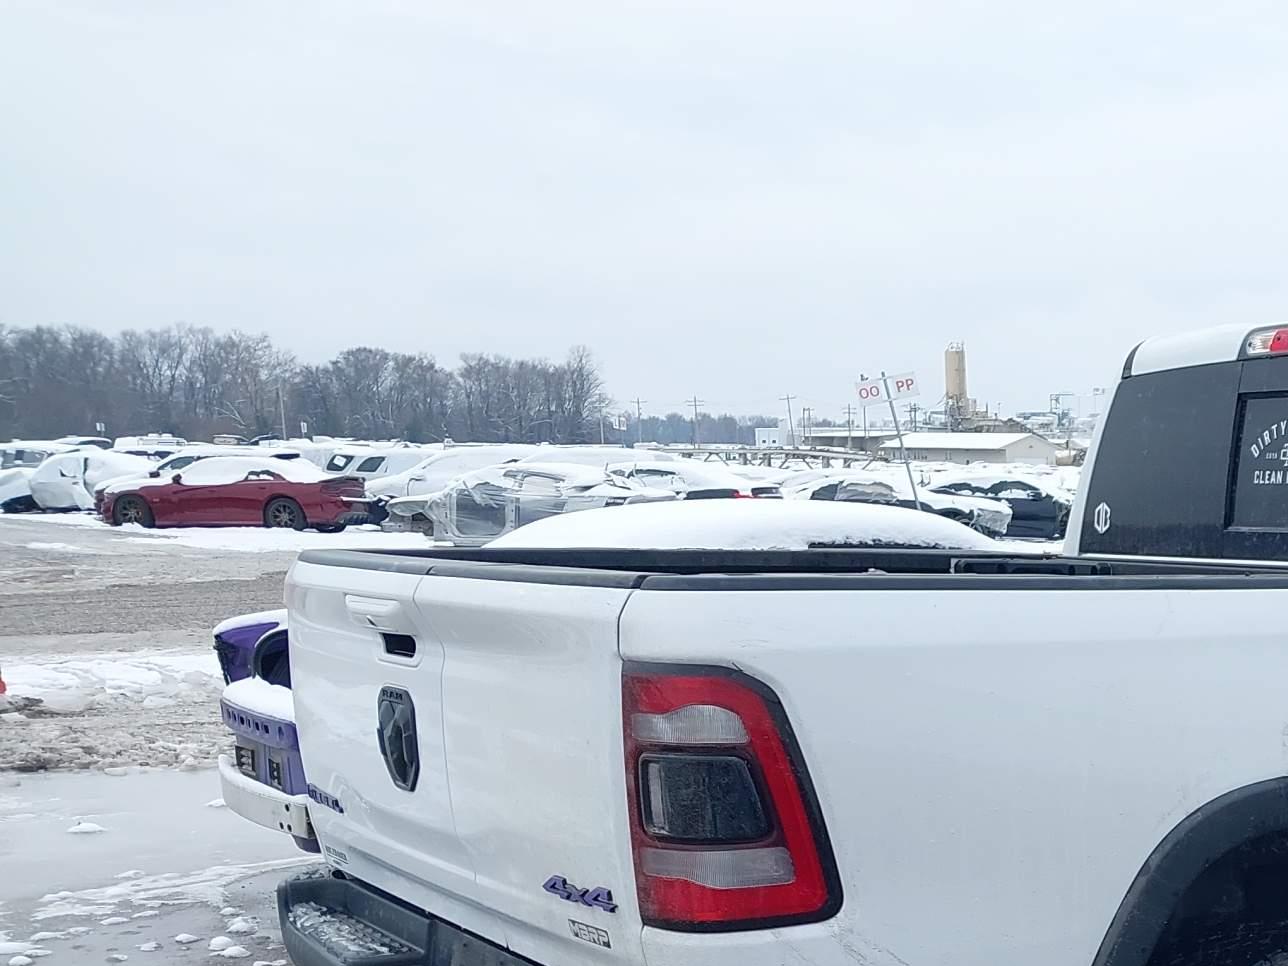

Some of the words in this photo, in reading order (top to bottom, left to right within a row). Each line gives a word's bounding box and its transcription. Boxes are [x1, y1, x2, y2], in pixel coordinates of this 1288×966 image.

[858, 385, 880, 399] OO
[896, 378, 914, 393] PP
[1250, 419, 1287, 458] DIRTY
[1253, 470, 1283, 484] CLEAN
[382, 689, 404, 701] RAM
[568, 920, 611, 948] MBRP
